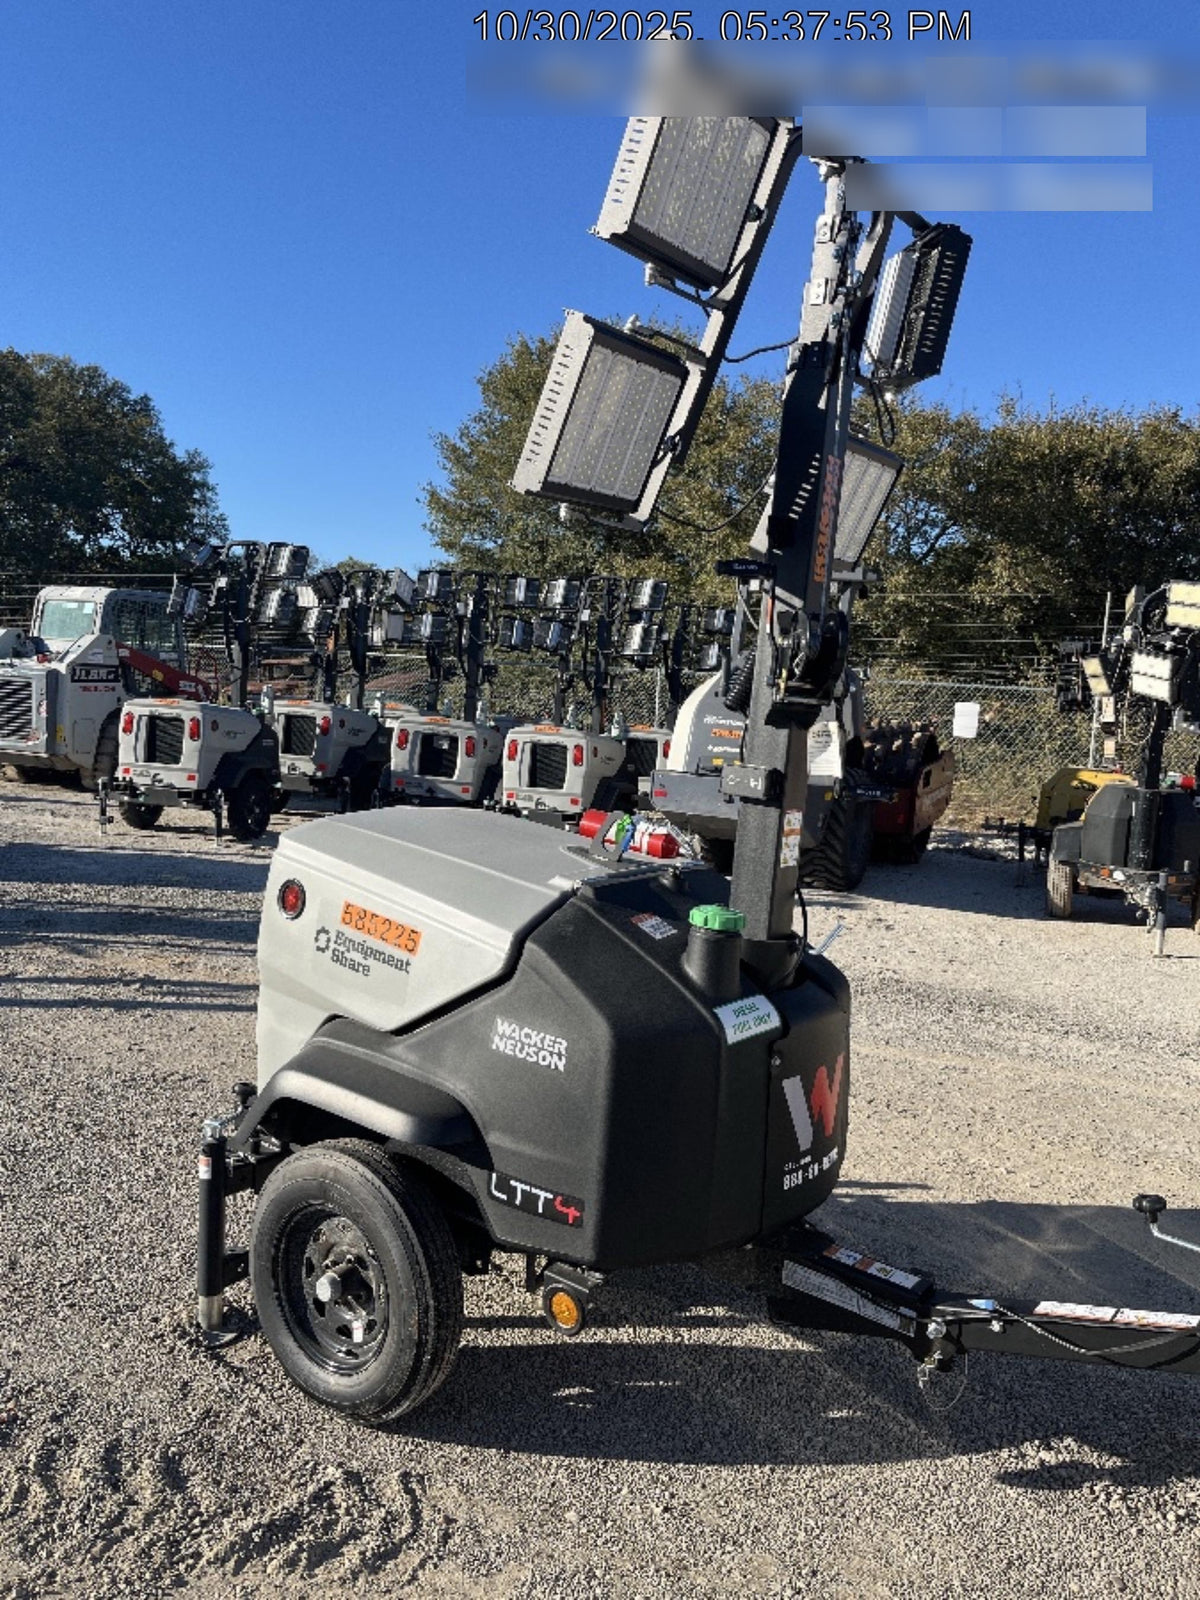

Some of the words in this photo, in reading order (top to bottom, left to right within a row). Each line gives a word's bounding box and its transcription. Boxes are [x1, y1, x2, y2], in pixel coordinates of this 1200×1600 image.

[331, 947, 371, 976] Share
[334, 930, 412, 975] Equipment
[492, 1034, 567, 1072] NEUSON
[497, 1018, 568, 1056] WACKER
[490, 1172, 581, 1224] LTT4
